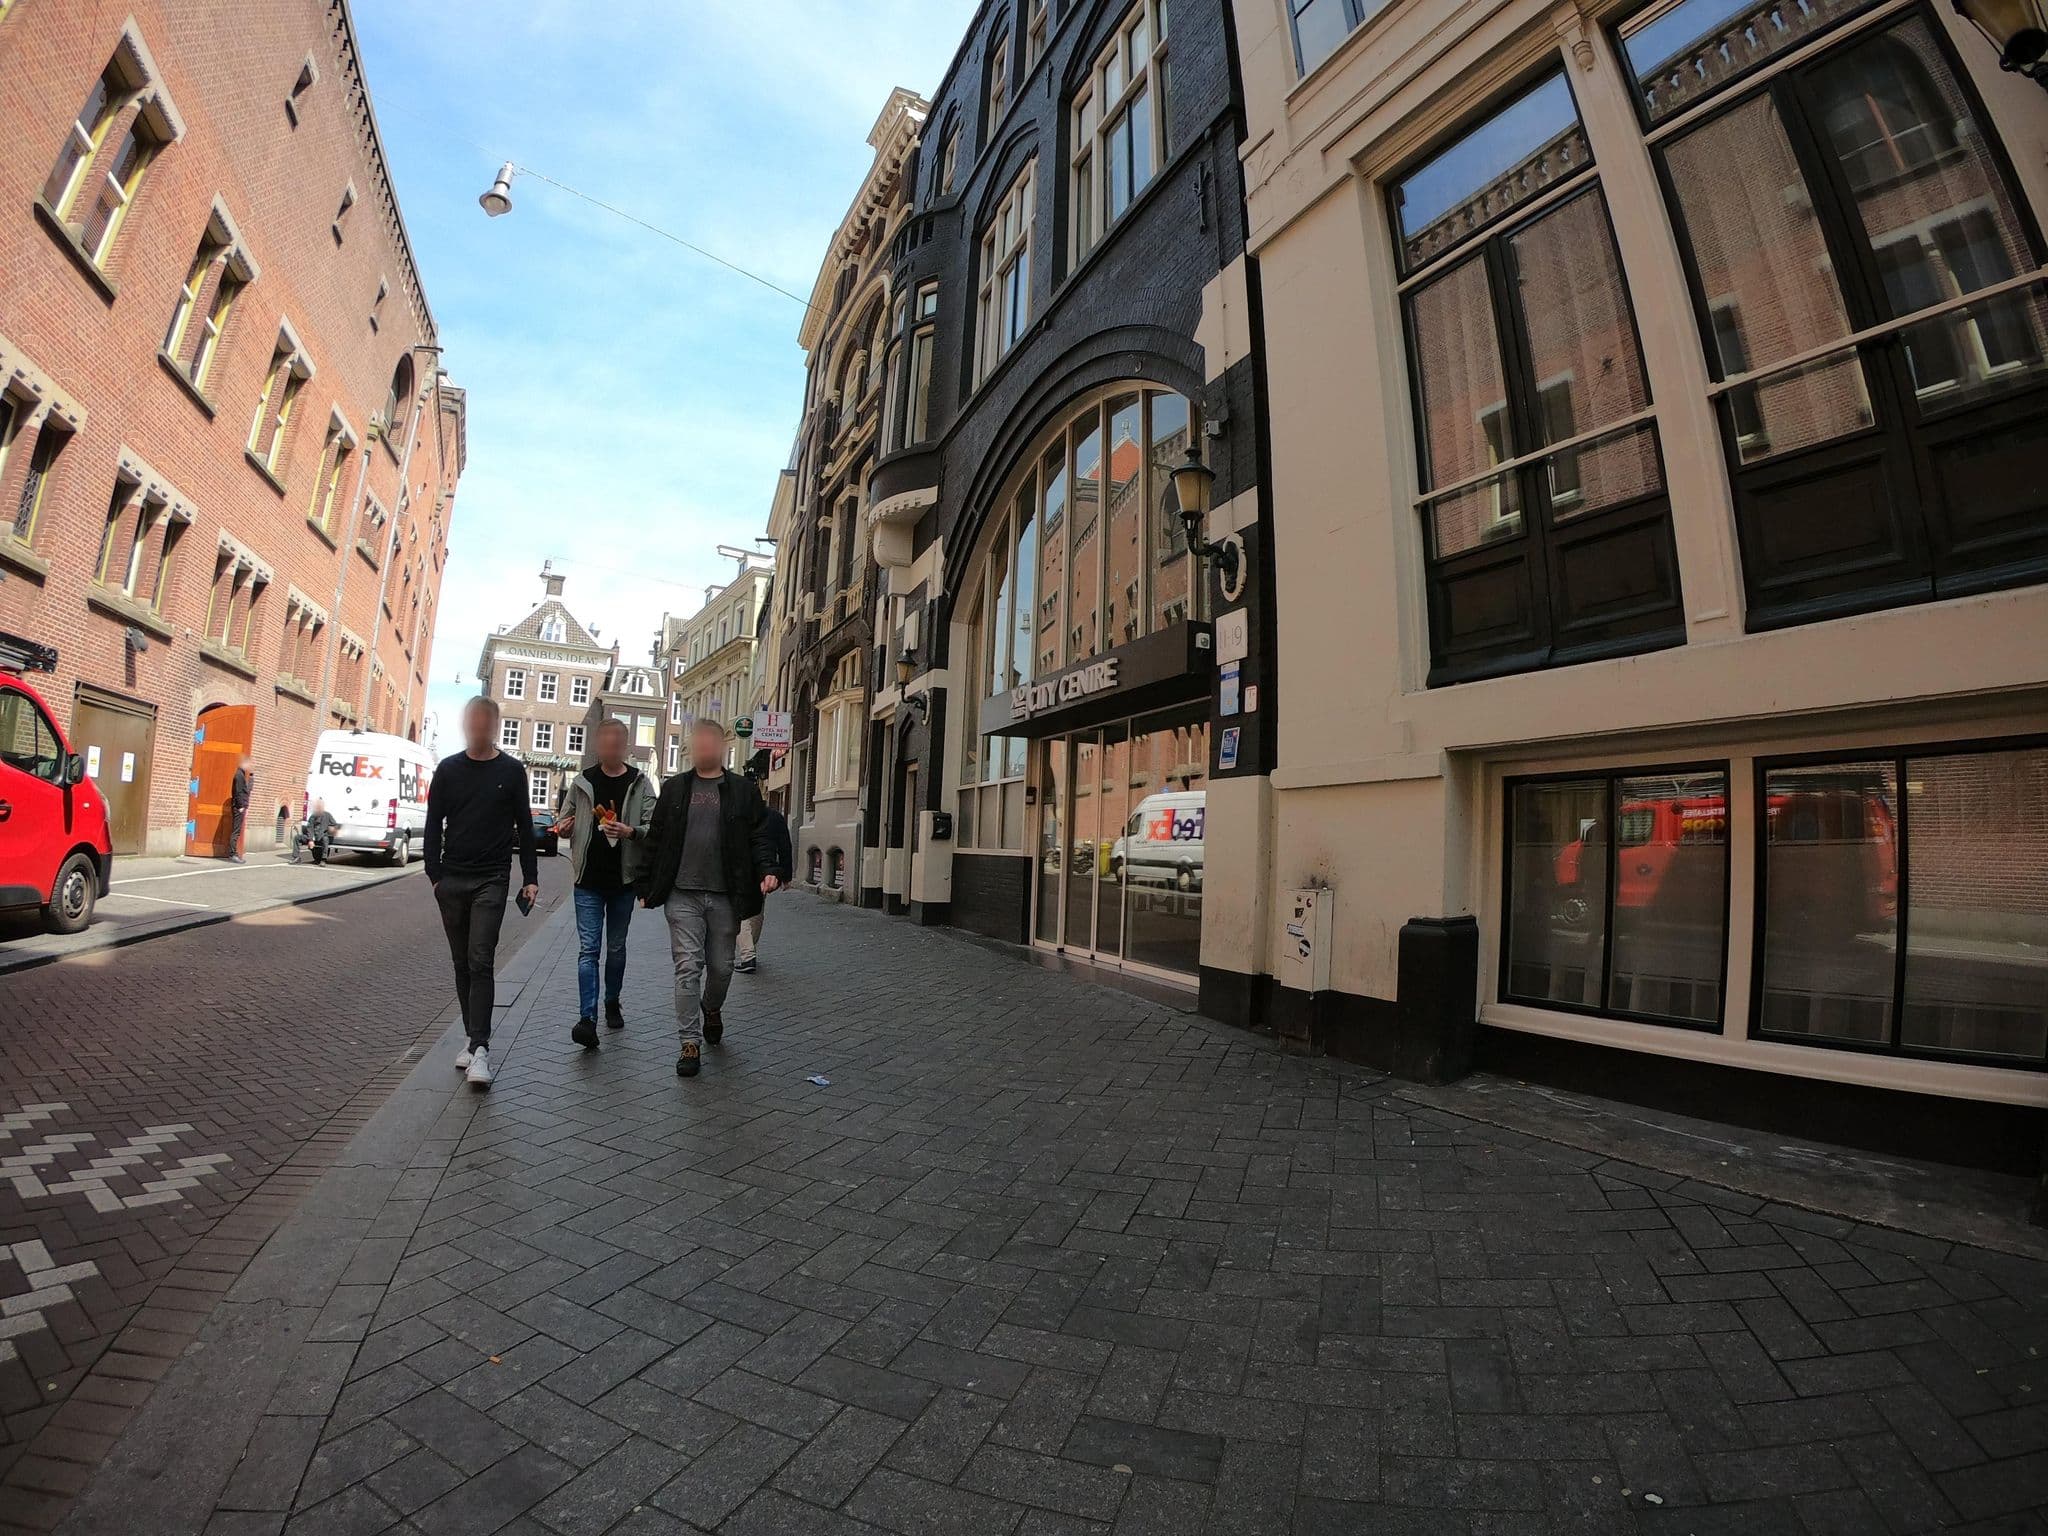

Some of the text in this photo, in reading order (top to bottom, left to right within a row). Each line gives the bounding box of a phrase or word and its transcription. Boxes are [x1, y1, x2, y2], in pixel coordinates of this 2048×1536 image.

[1028, 679, 1060, 712] CITY
[1059, 658, 1119, 701] CENTRE
[319, 754, 384, 779] FedEx
